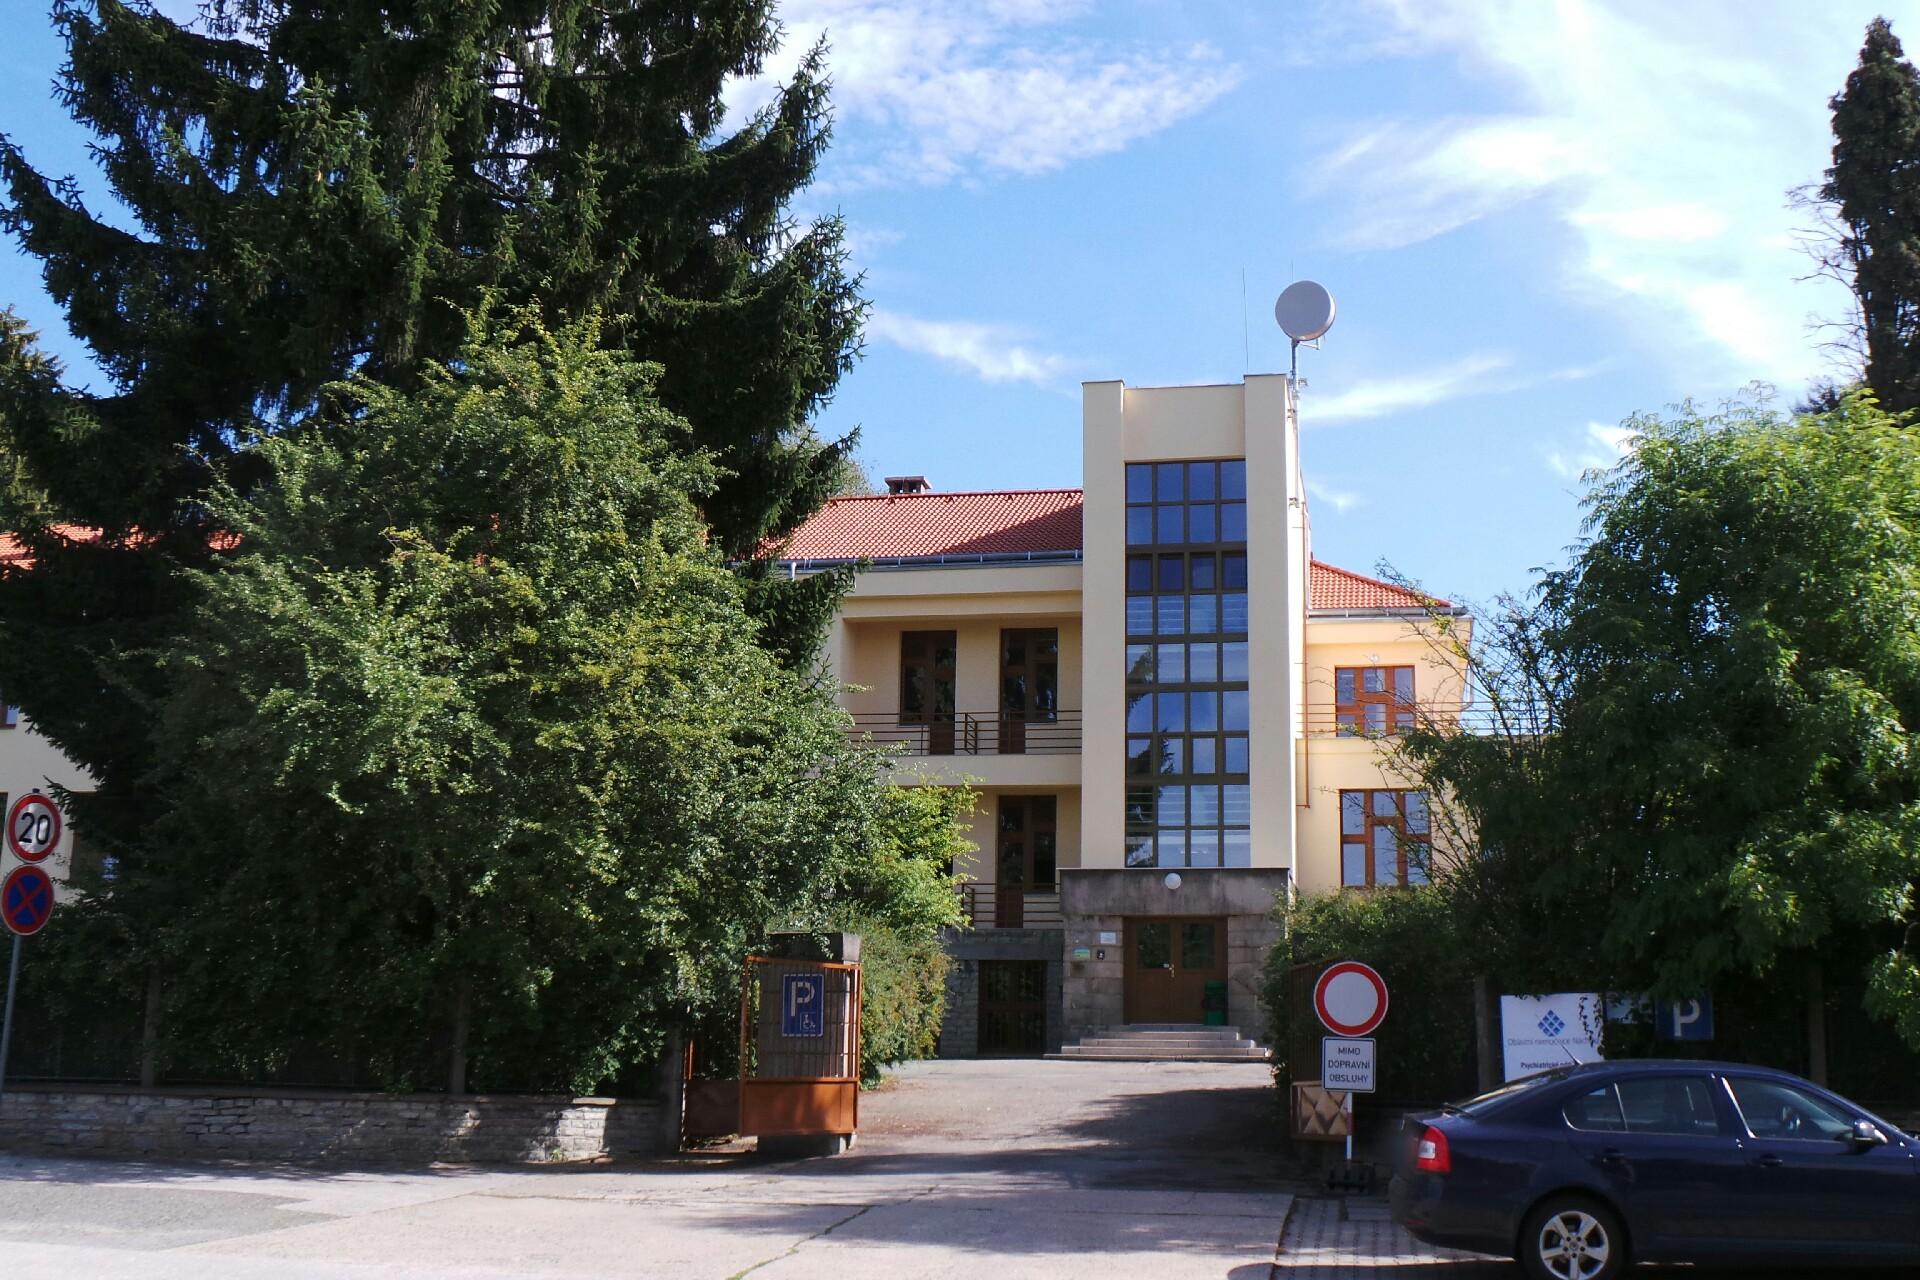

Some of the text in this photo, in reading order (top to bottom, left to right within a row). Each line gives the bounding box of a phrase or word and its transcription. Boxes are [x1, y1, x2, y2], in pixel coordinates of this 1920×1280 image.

[19, 812, 51, 845] 20
[791, 981, 815, 1017] P
[1673, 999, 1700, 1037] P
[1338, 1047, 1361, 1055] MIMO
[1329, 1073, 1369, 1083] OBSLUHY
